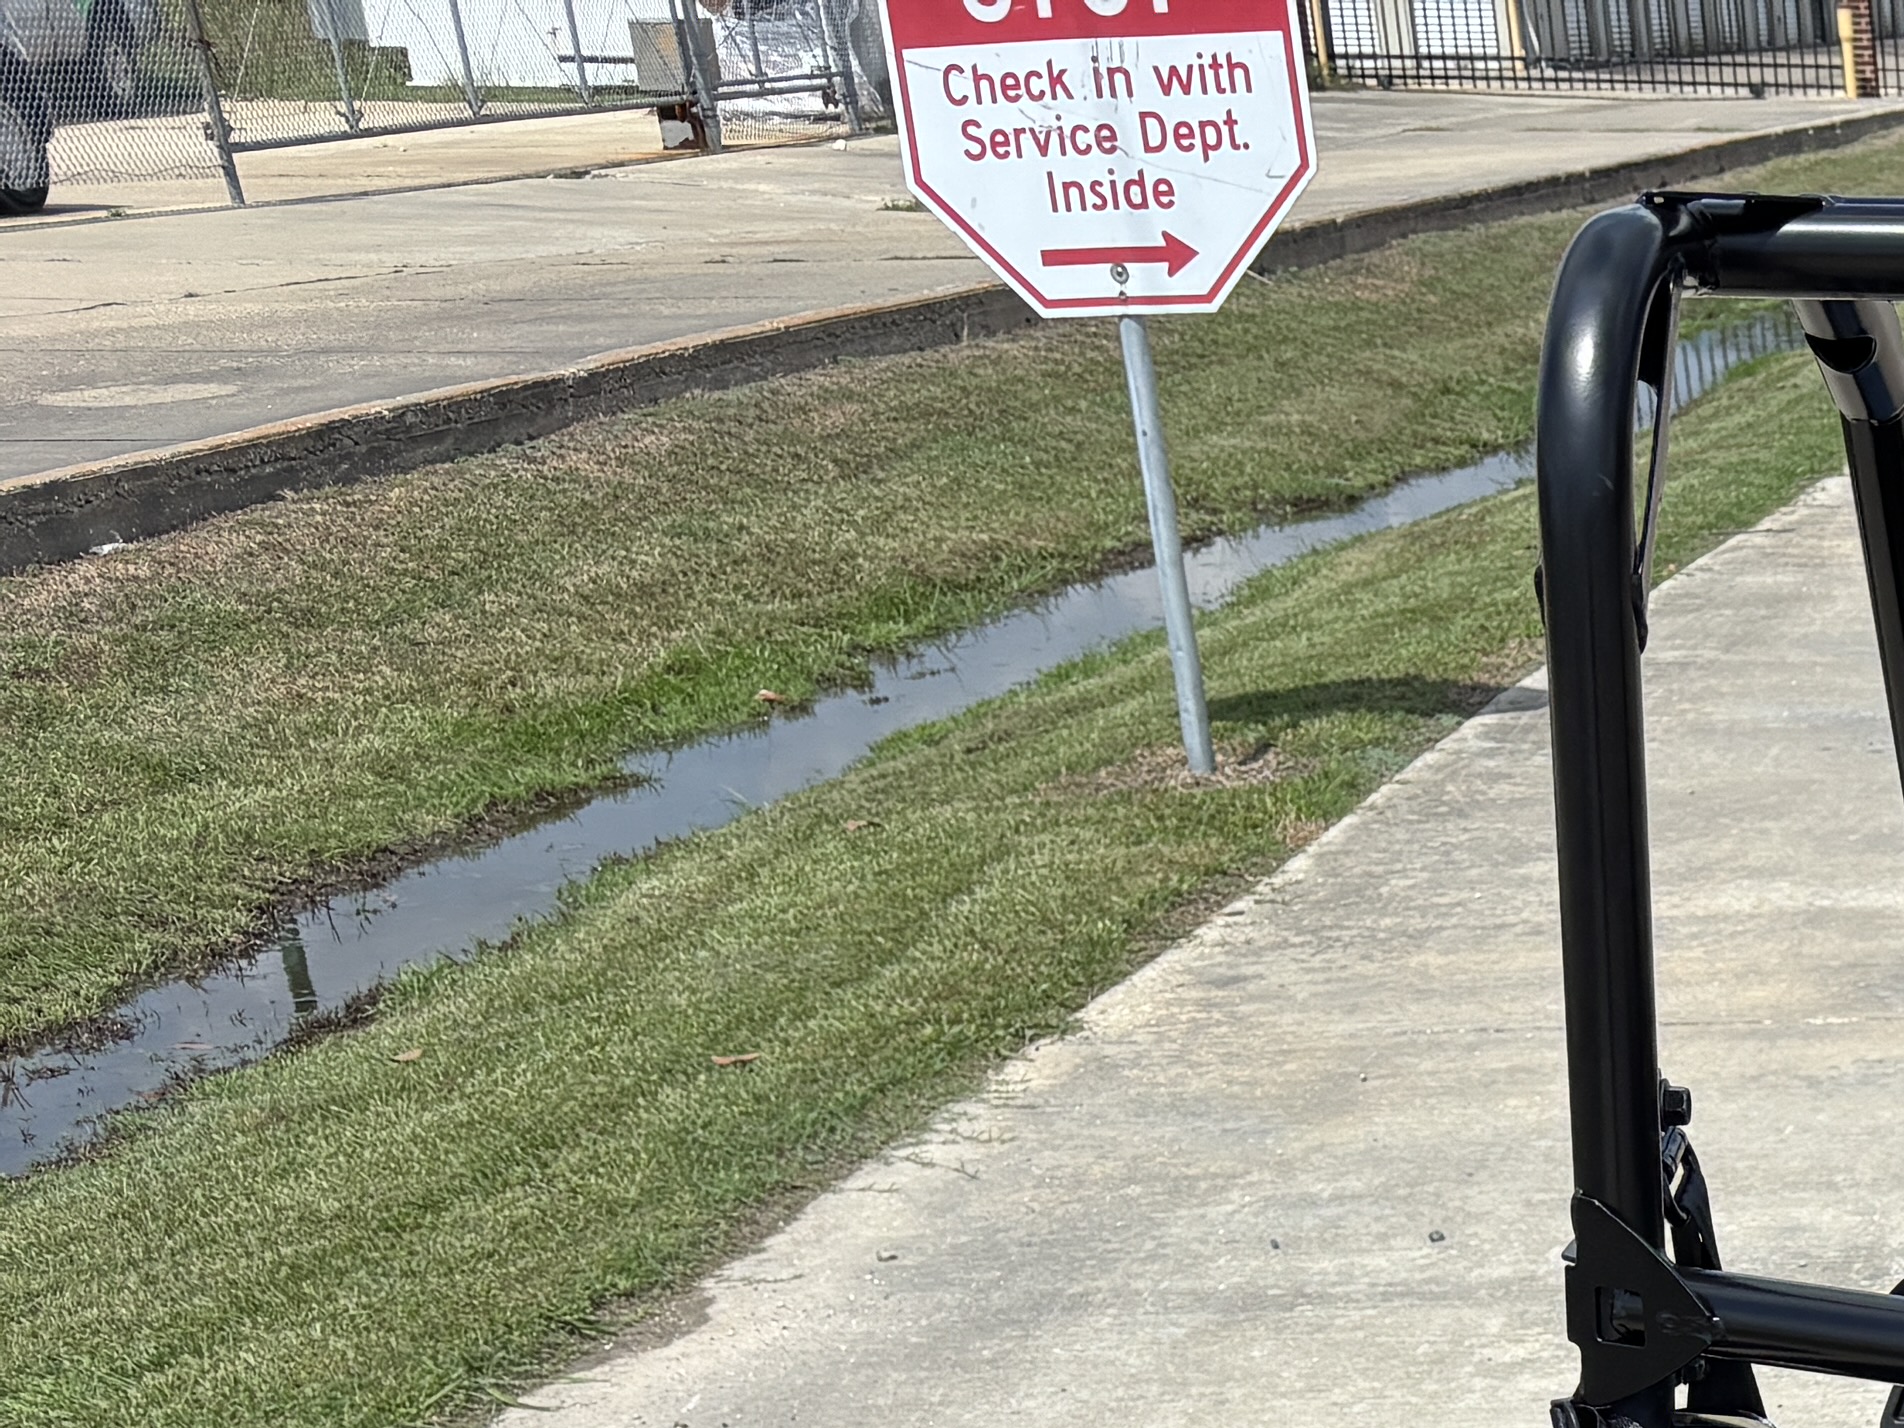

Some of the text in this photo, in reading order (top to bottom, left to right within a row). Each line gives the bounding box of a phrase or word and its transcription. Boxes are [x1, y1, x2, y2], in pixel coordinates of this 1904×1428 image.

[943, 52, 1252, 107] Check in with
[962, 109, 1250, 163] Service Dept.
[1047, 168, 1175, 213] Inside
